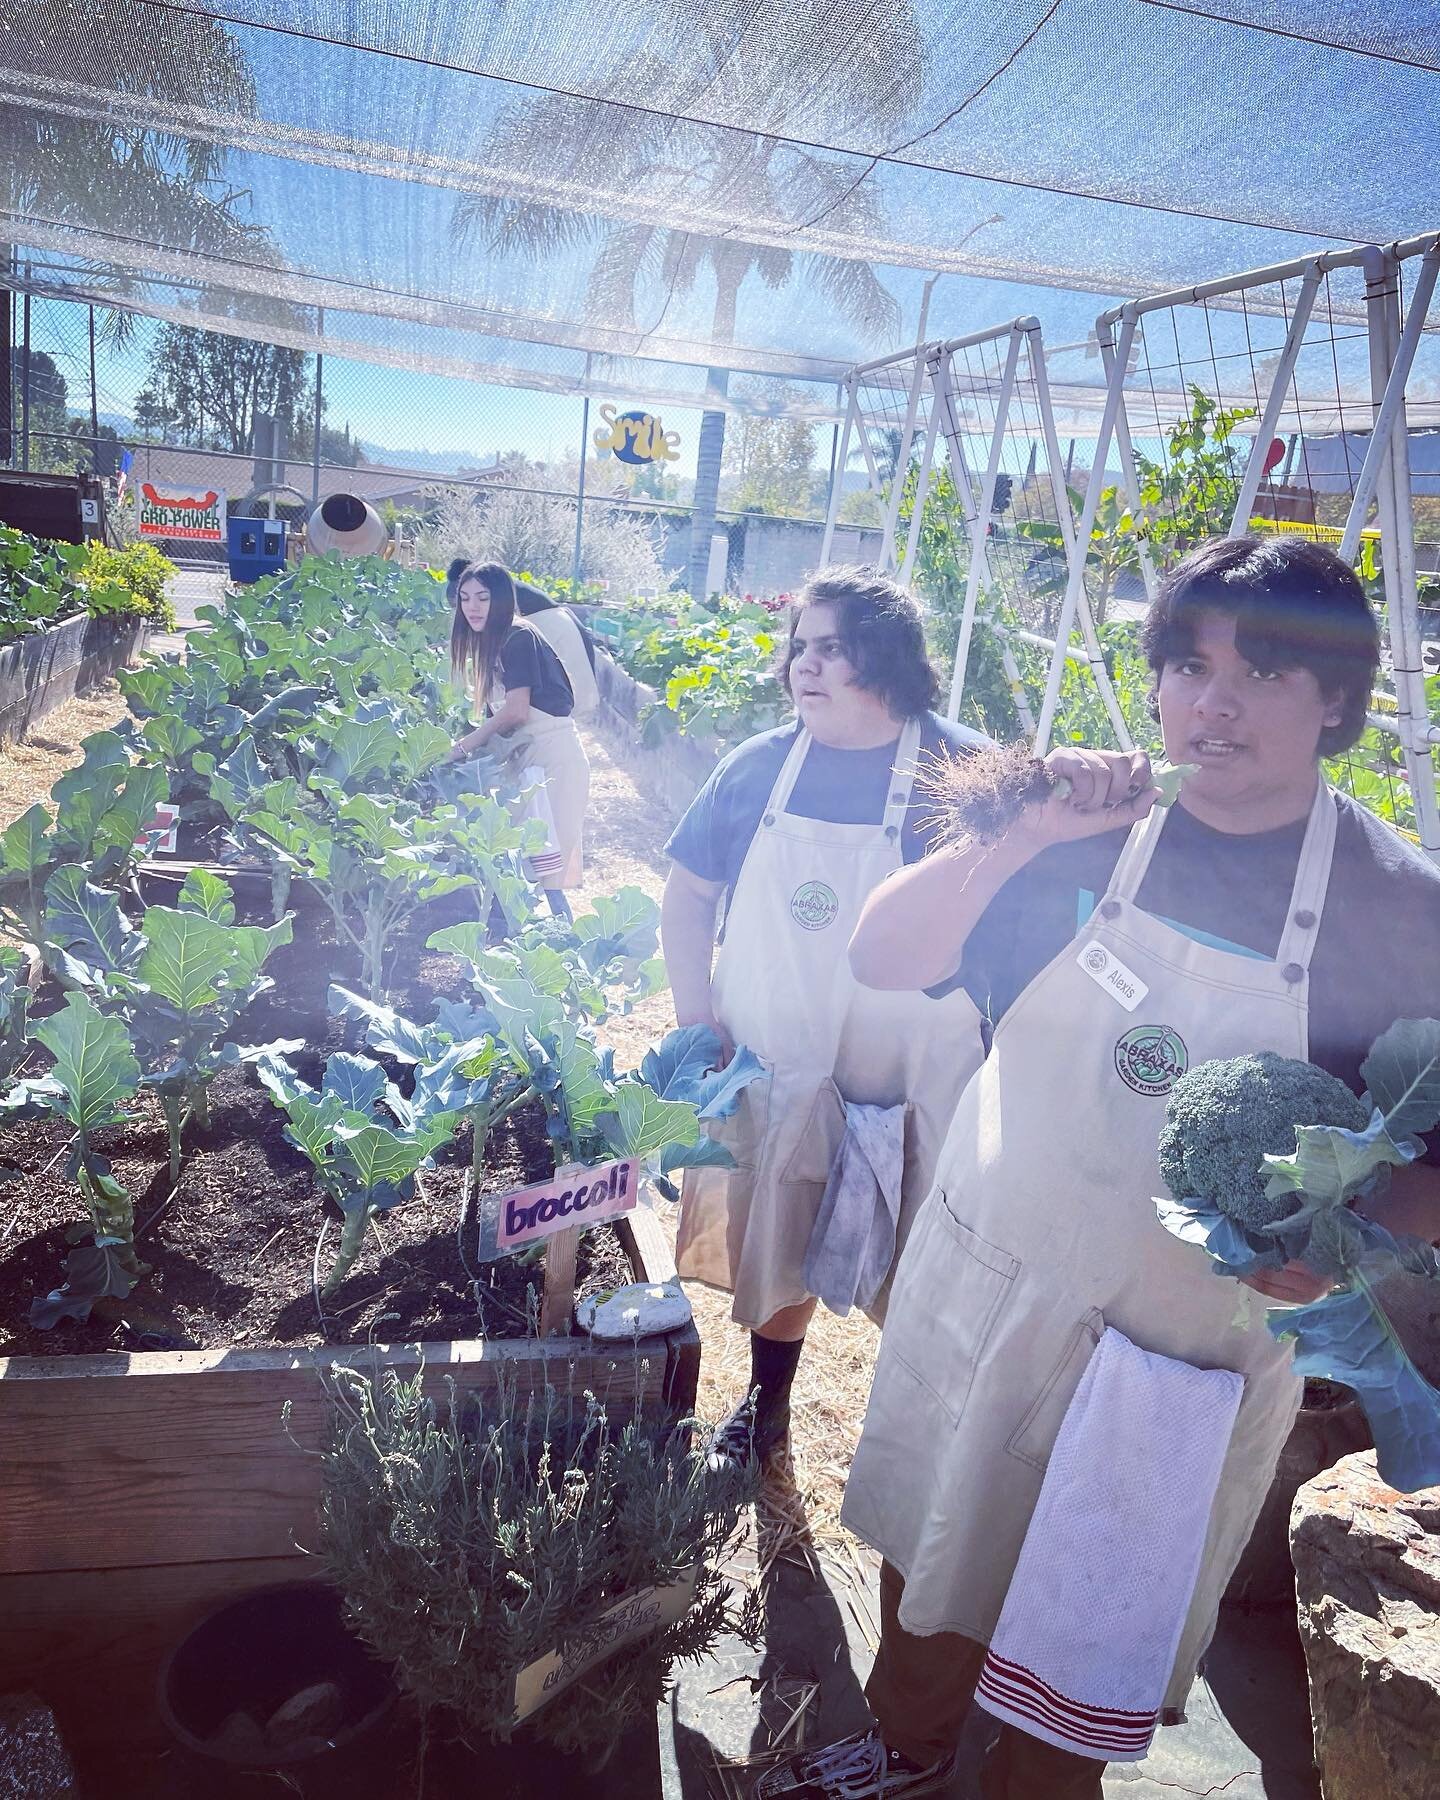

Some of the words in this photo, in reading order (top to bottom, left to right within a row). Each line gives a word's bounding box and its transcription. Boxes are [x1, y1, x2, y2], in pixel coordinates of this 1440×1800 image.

[593, 403, 681, 462] Smile
[85, 502, 95, 517] 3
[140, 507, 220, 530] GRO-POWER
[792, 899, 837, 913] ABRAXAS
[1107, 969, 1135, 999] Alexis
[1118, 1041, 1184, 1079] ABRAXAS
[1118, 1058, 1139, 1087] GARDEN
[1138, 1081, 1172, 1093] KITCHEN
[505, 1163, 630, 1236] broccoli
